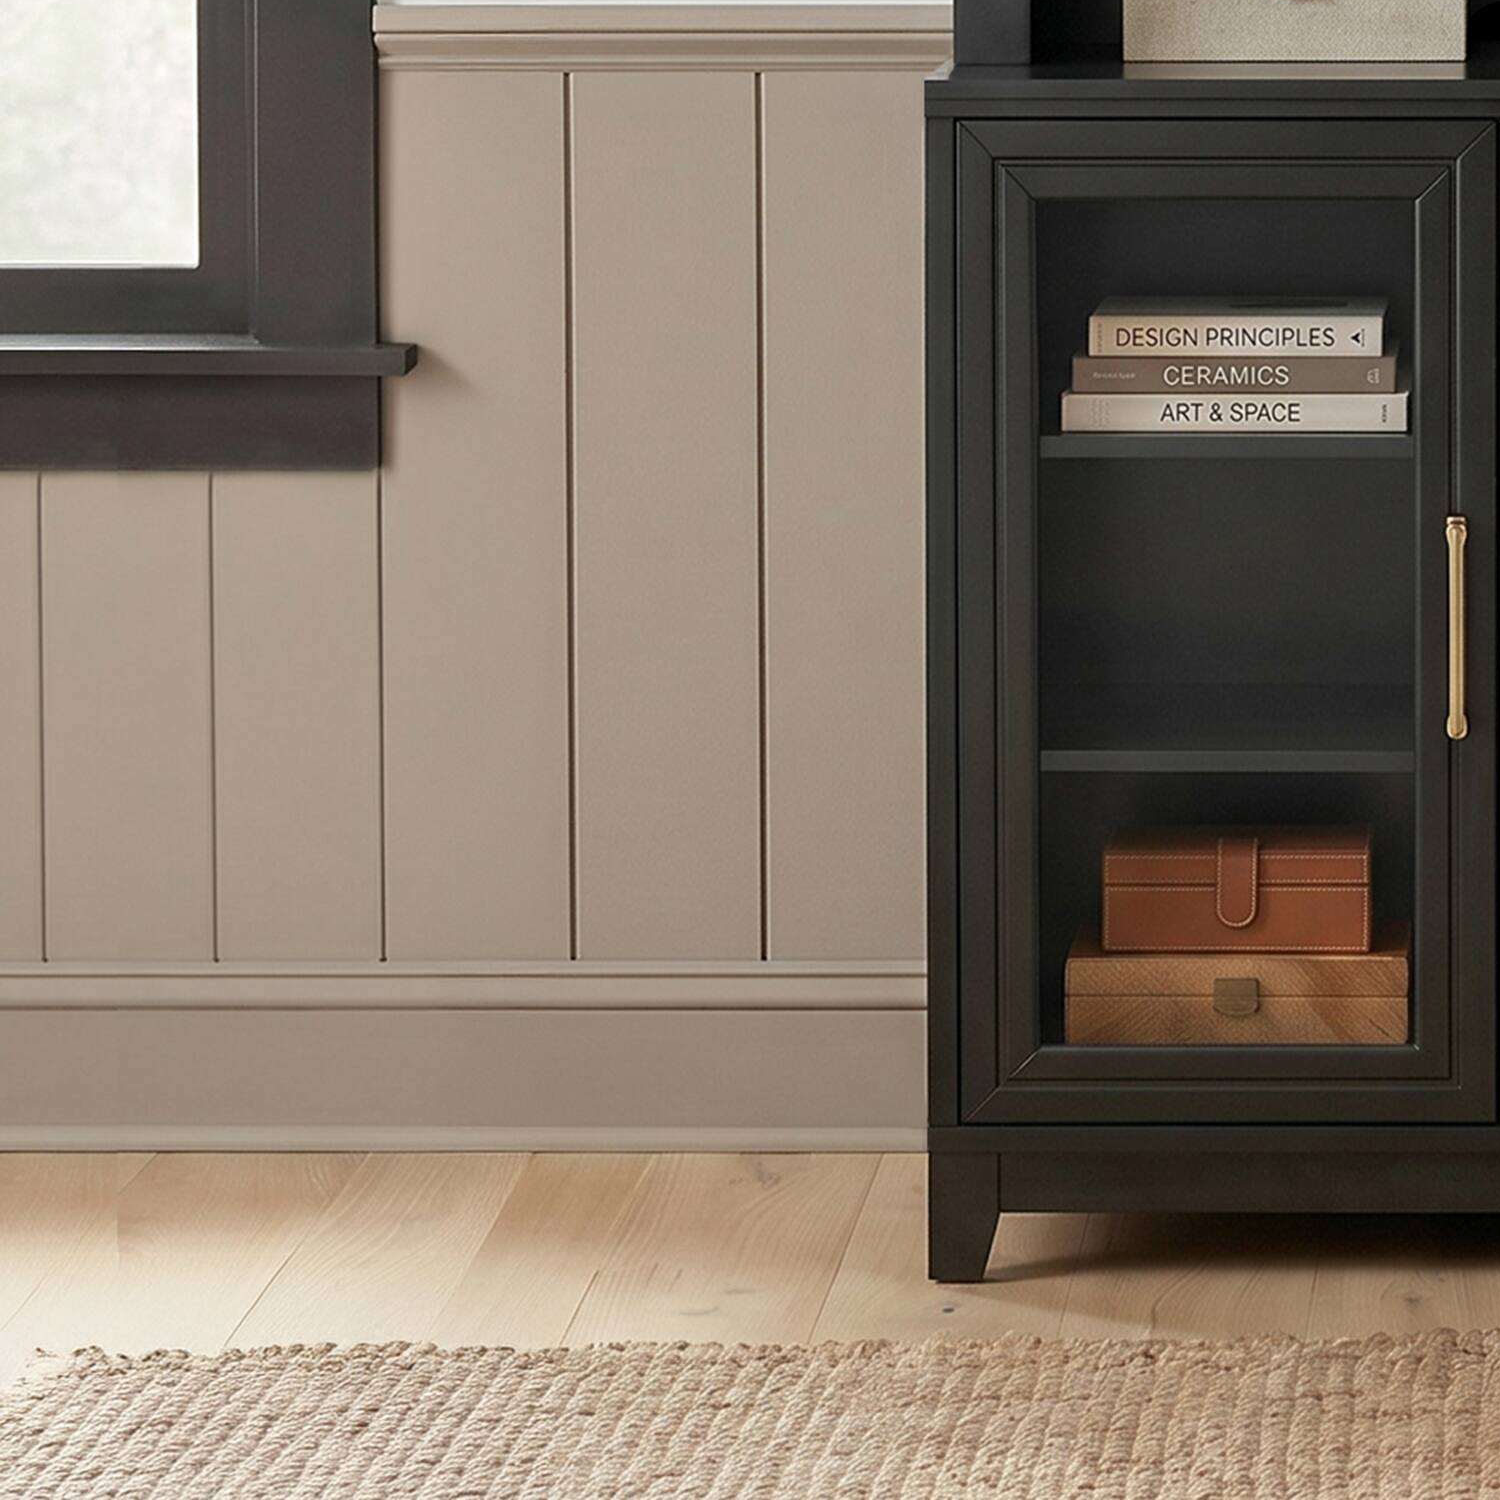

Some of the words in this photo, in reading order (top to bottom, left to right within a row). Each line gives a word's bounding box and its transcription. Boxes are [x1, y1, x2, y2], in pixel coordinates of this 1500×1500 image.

[1115, 327, 1198, 347] DESIGN
[1205, 327, 1336, 347] PRINCIPLES
[1163, 366, 1290, 385] CERAMICS
[1160, 403, 1204, 422] ART
[1208, 402, 1224, 423] &
[1229, 403, 1301, 422] SPACE
